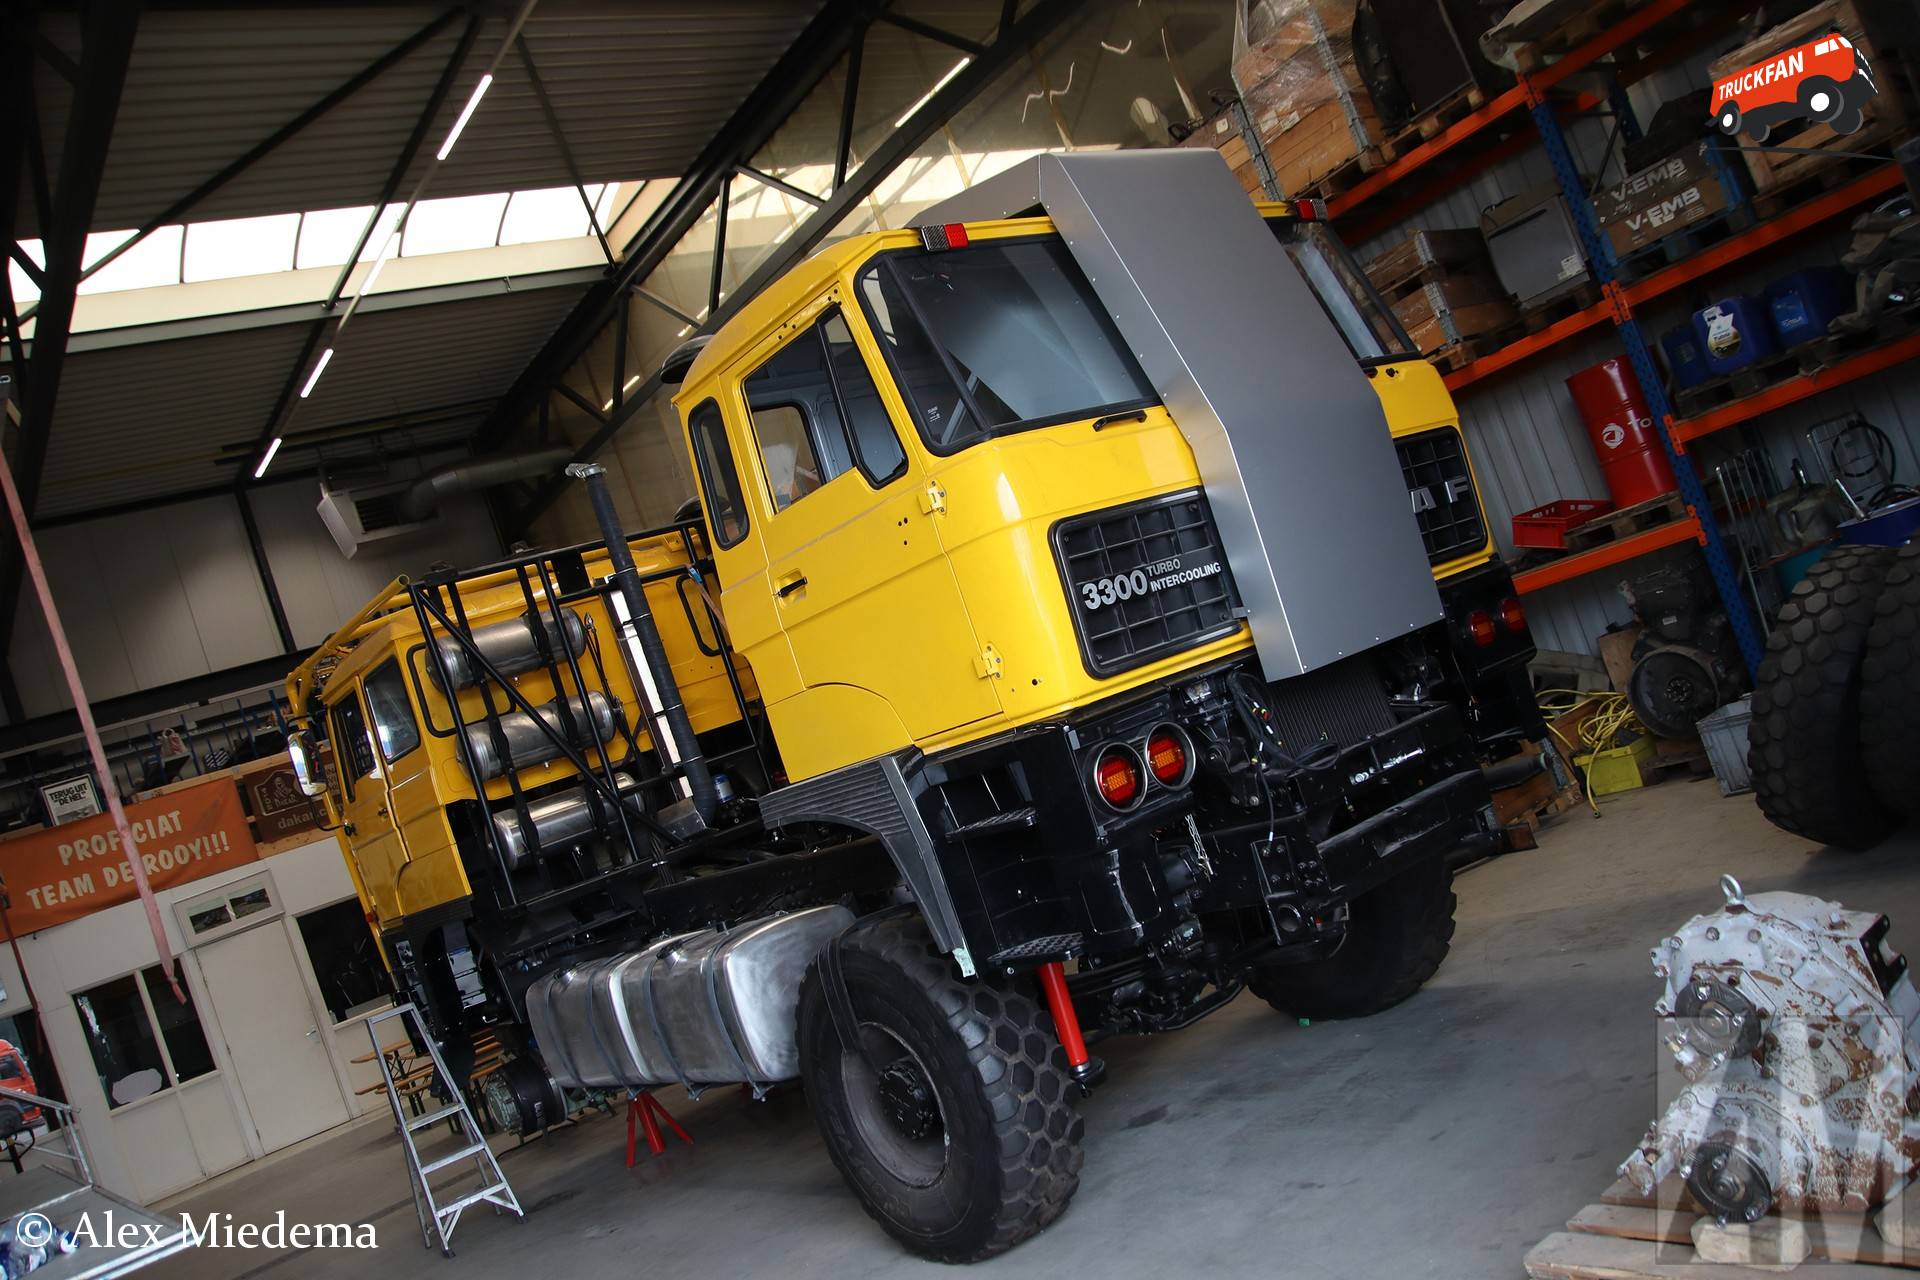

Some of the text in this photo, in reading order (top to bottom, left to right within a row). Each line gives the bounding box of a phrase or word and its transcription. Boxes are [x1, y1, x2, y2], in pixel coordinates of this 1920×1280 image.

[1625, 187, 1700, 231] V-EMB
[1408, 475, 1469, 514] AF
[1147, 557, 1181, 577] TURBO
[1150, 561, 1222, 592] INTERCOOLING
[1081, 569, 1148, 611] 3300
[57, 810, 183, 867] PROFCIAT
[26, 830, 232, 911] TEAM DE ROOY!!!
